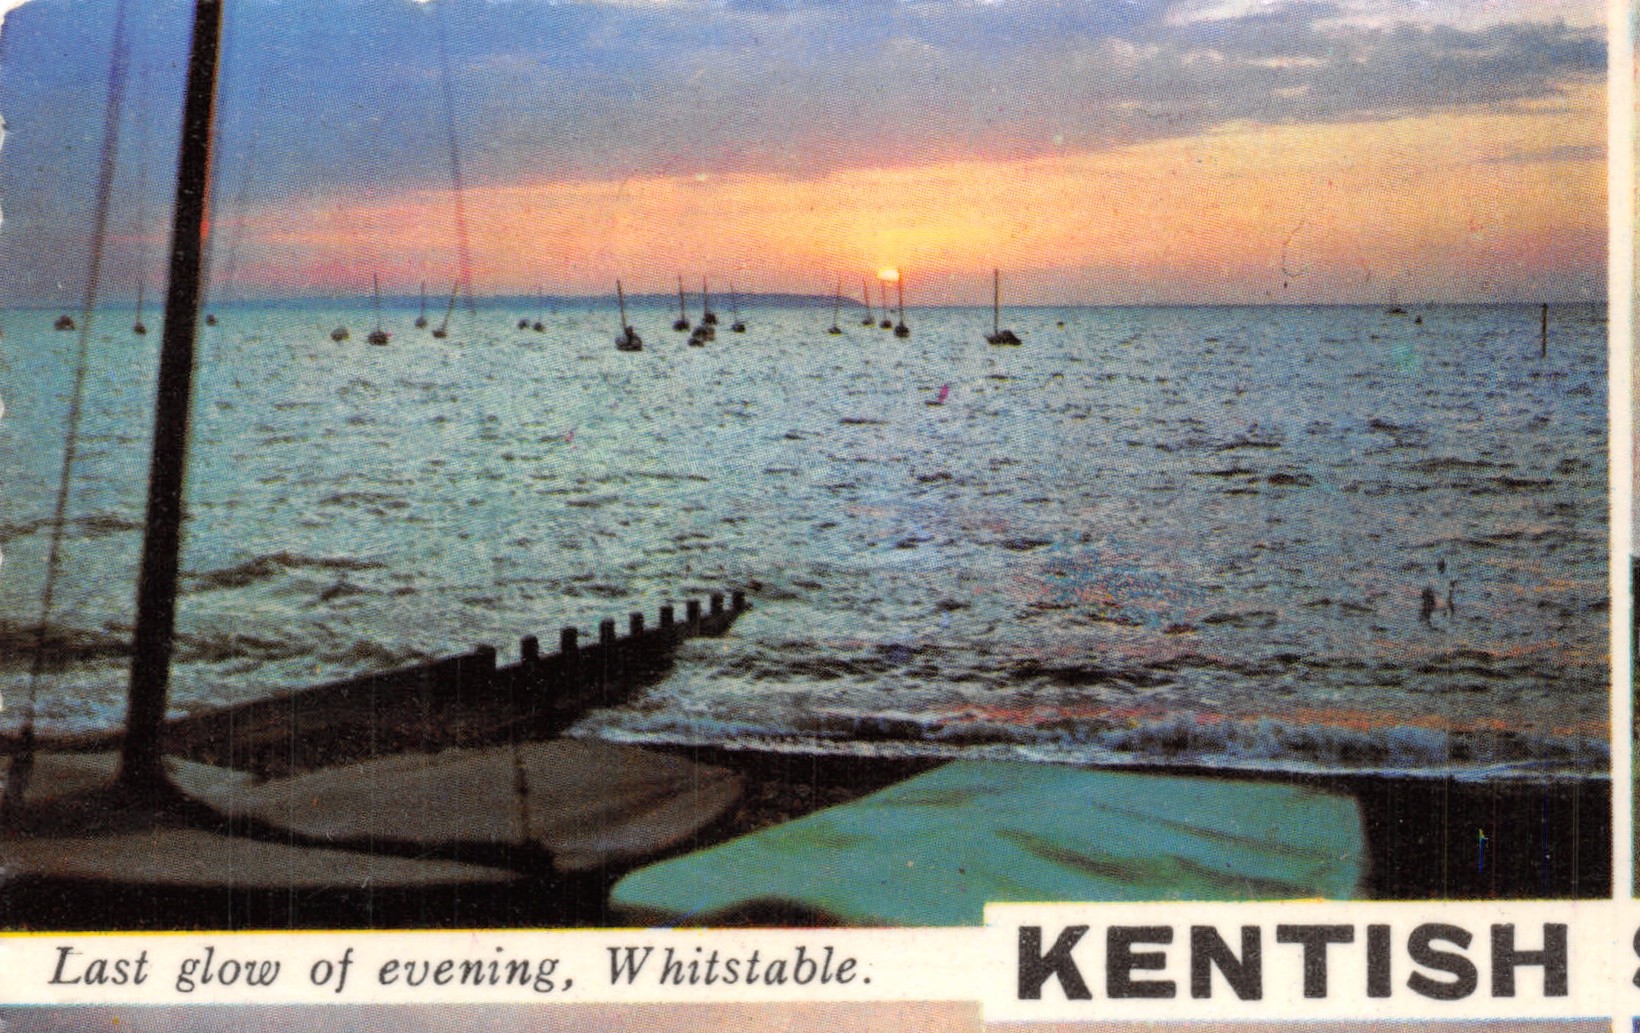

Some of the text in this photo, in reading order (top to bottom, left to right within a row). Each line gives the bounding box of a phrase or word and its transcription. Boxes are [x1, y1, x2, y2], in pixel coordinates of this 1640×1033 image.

[48, 945, 873, 994] Last glow of evening, Whitstable.
[1017, 922, 1569, 1001] KENTISH
